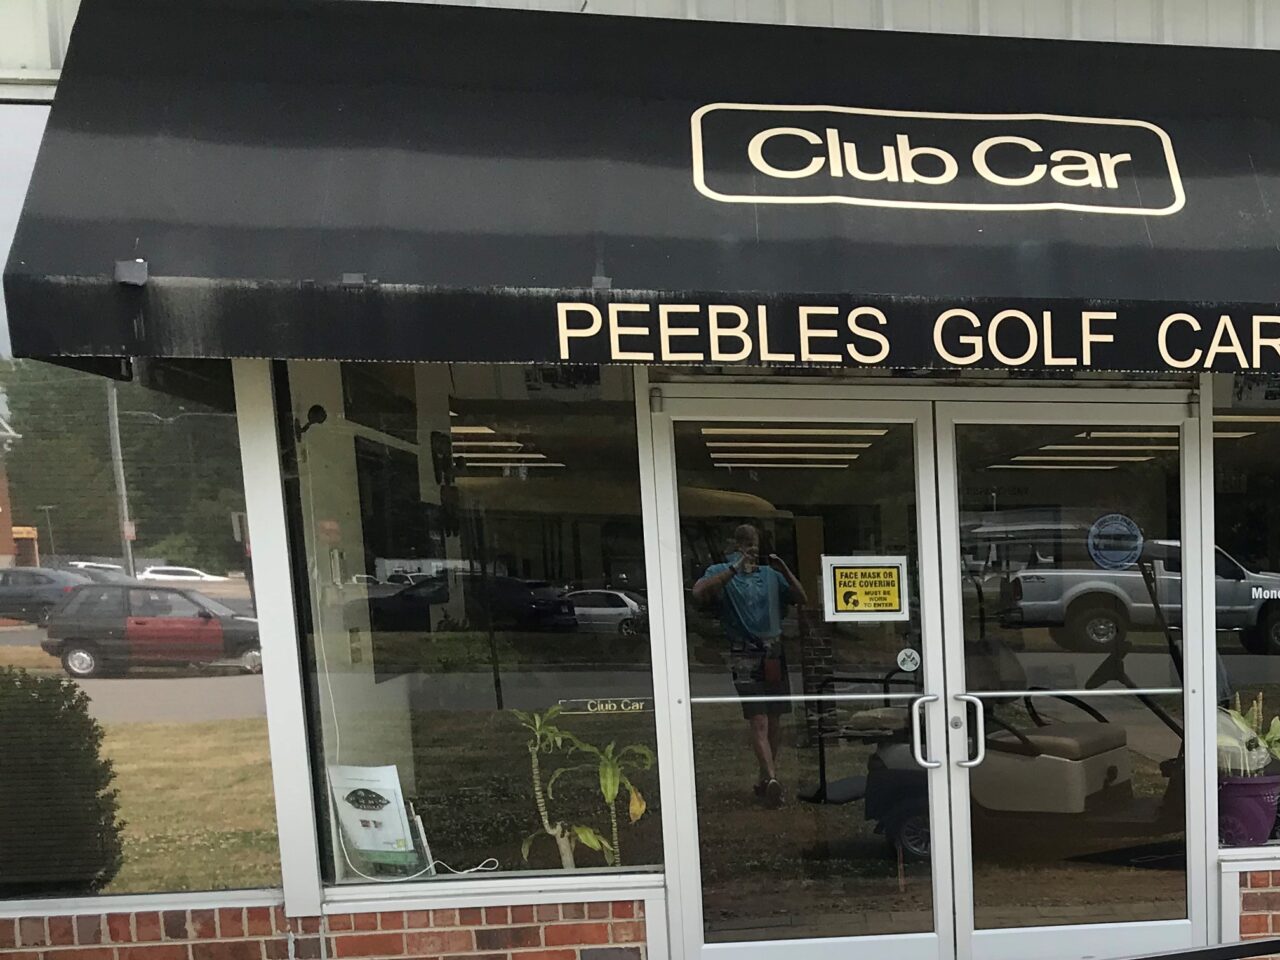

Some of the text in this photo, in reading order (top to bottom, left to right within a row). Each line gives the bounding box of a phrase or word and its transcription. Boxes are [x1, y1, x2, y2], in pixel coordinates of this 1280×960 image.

[747, 126, 1133, 190] Club Car
[557, 302, 891, 366] PEEBLES
[933, 308, 1118, 368] GOLF
[883, 571, 893, 579] OR
[839, 580, 896, 588] FACE COVERING
[588, 699, 644, 711] Club Car
